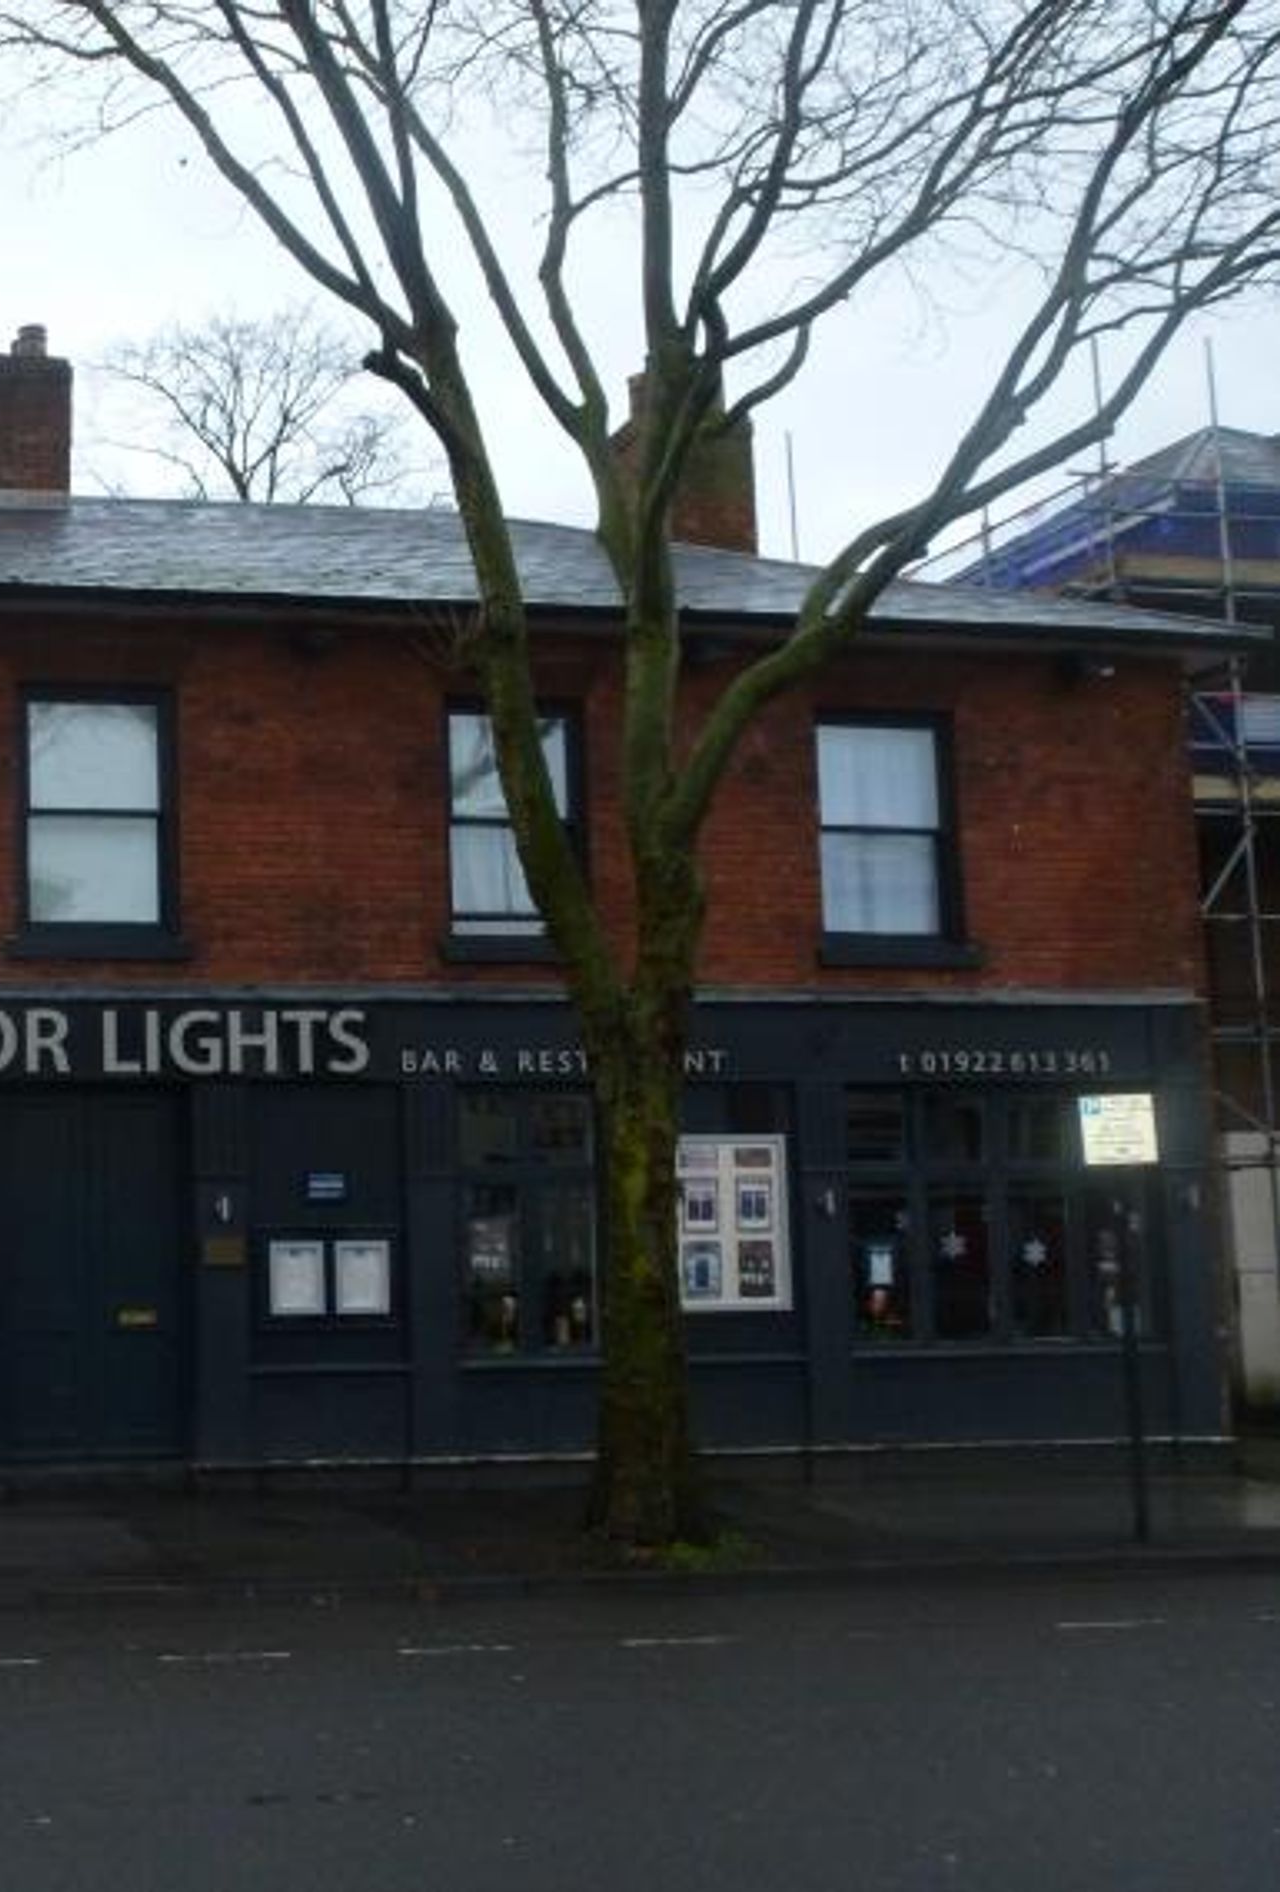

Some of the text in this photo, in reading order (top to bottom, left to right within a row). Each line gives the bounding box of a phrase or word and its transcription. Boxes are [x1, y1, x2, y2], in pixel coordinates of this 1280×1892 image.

[102, 1009, 370, 1074] LIGHTS
[400, 1049, 728, 1073] BAR & RESTNT
